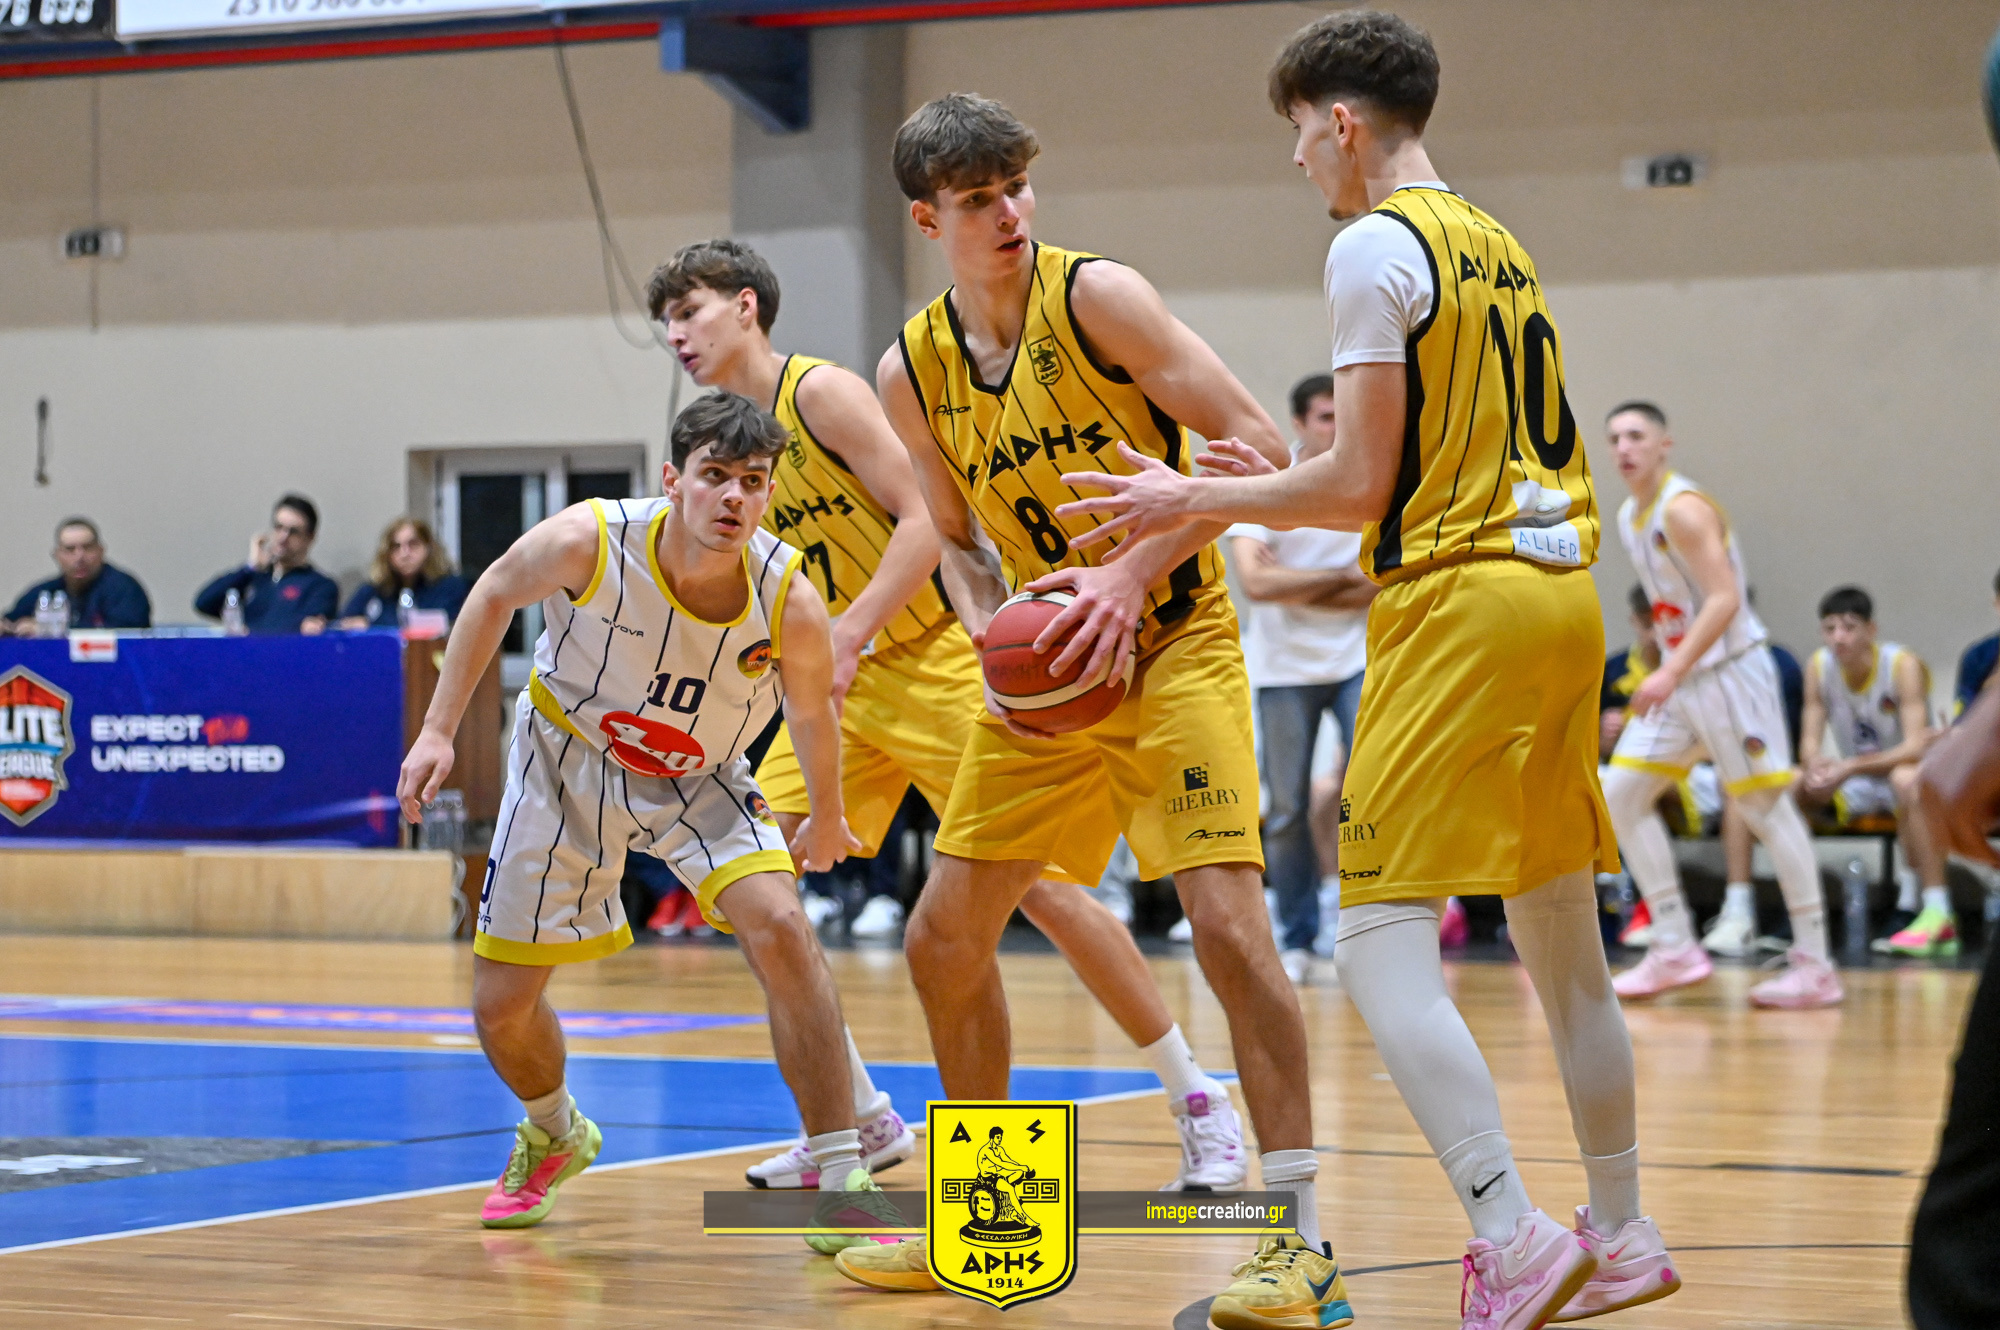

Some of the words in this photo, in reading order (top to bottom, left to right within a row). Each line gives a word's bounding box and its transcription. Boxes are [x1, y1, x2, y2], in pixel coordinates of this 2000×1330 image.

[1488, 303, 1577, 472] 10
[1014, 495, 1069, 564] 8
[1518, 531, 1579, 563] ALLER
[601, 616, 645, 638] GIVOVA
[646, 672, 707, 715] 10
[91, 714, 204, 742] EXPECT
[91, 744, 286, 773] UNEXPECTED
[1164, 788, 1241, 815] CHERRY
